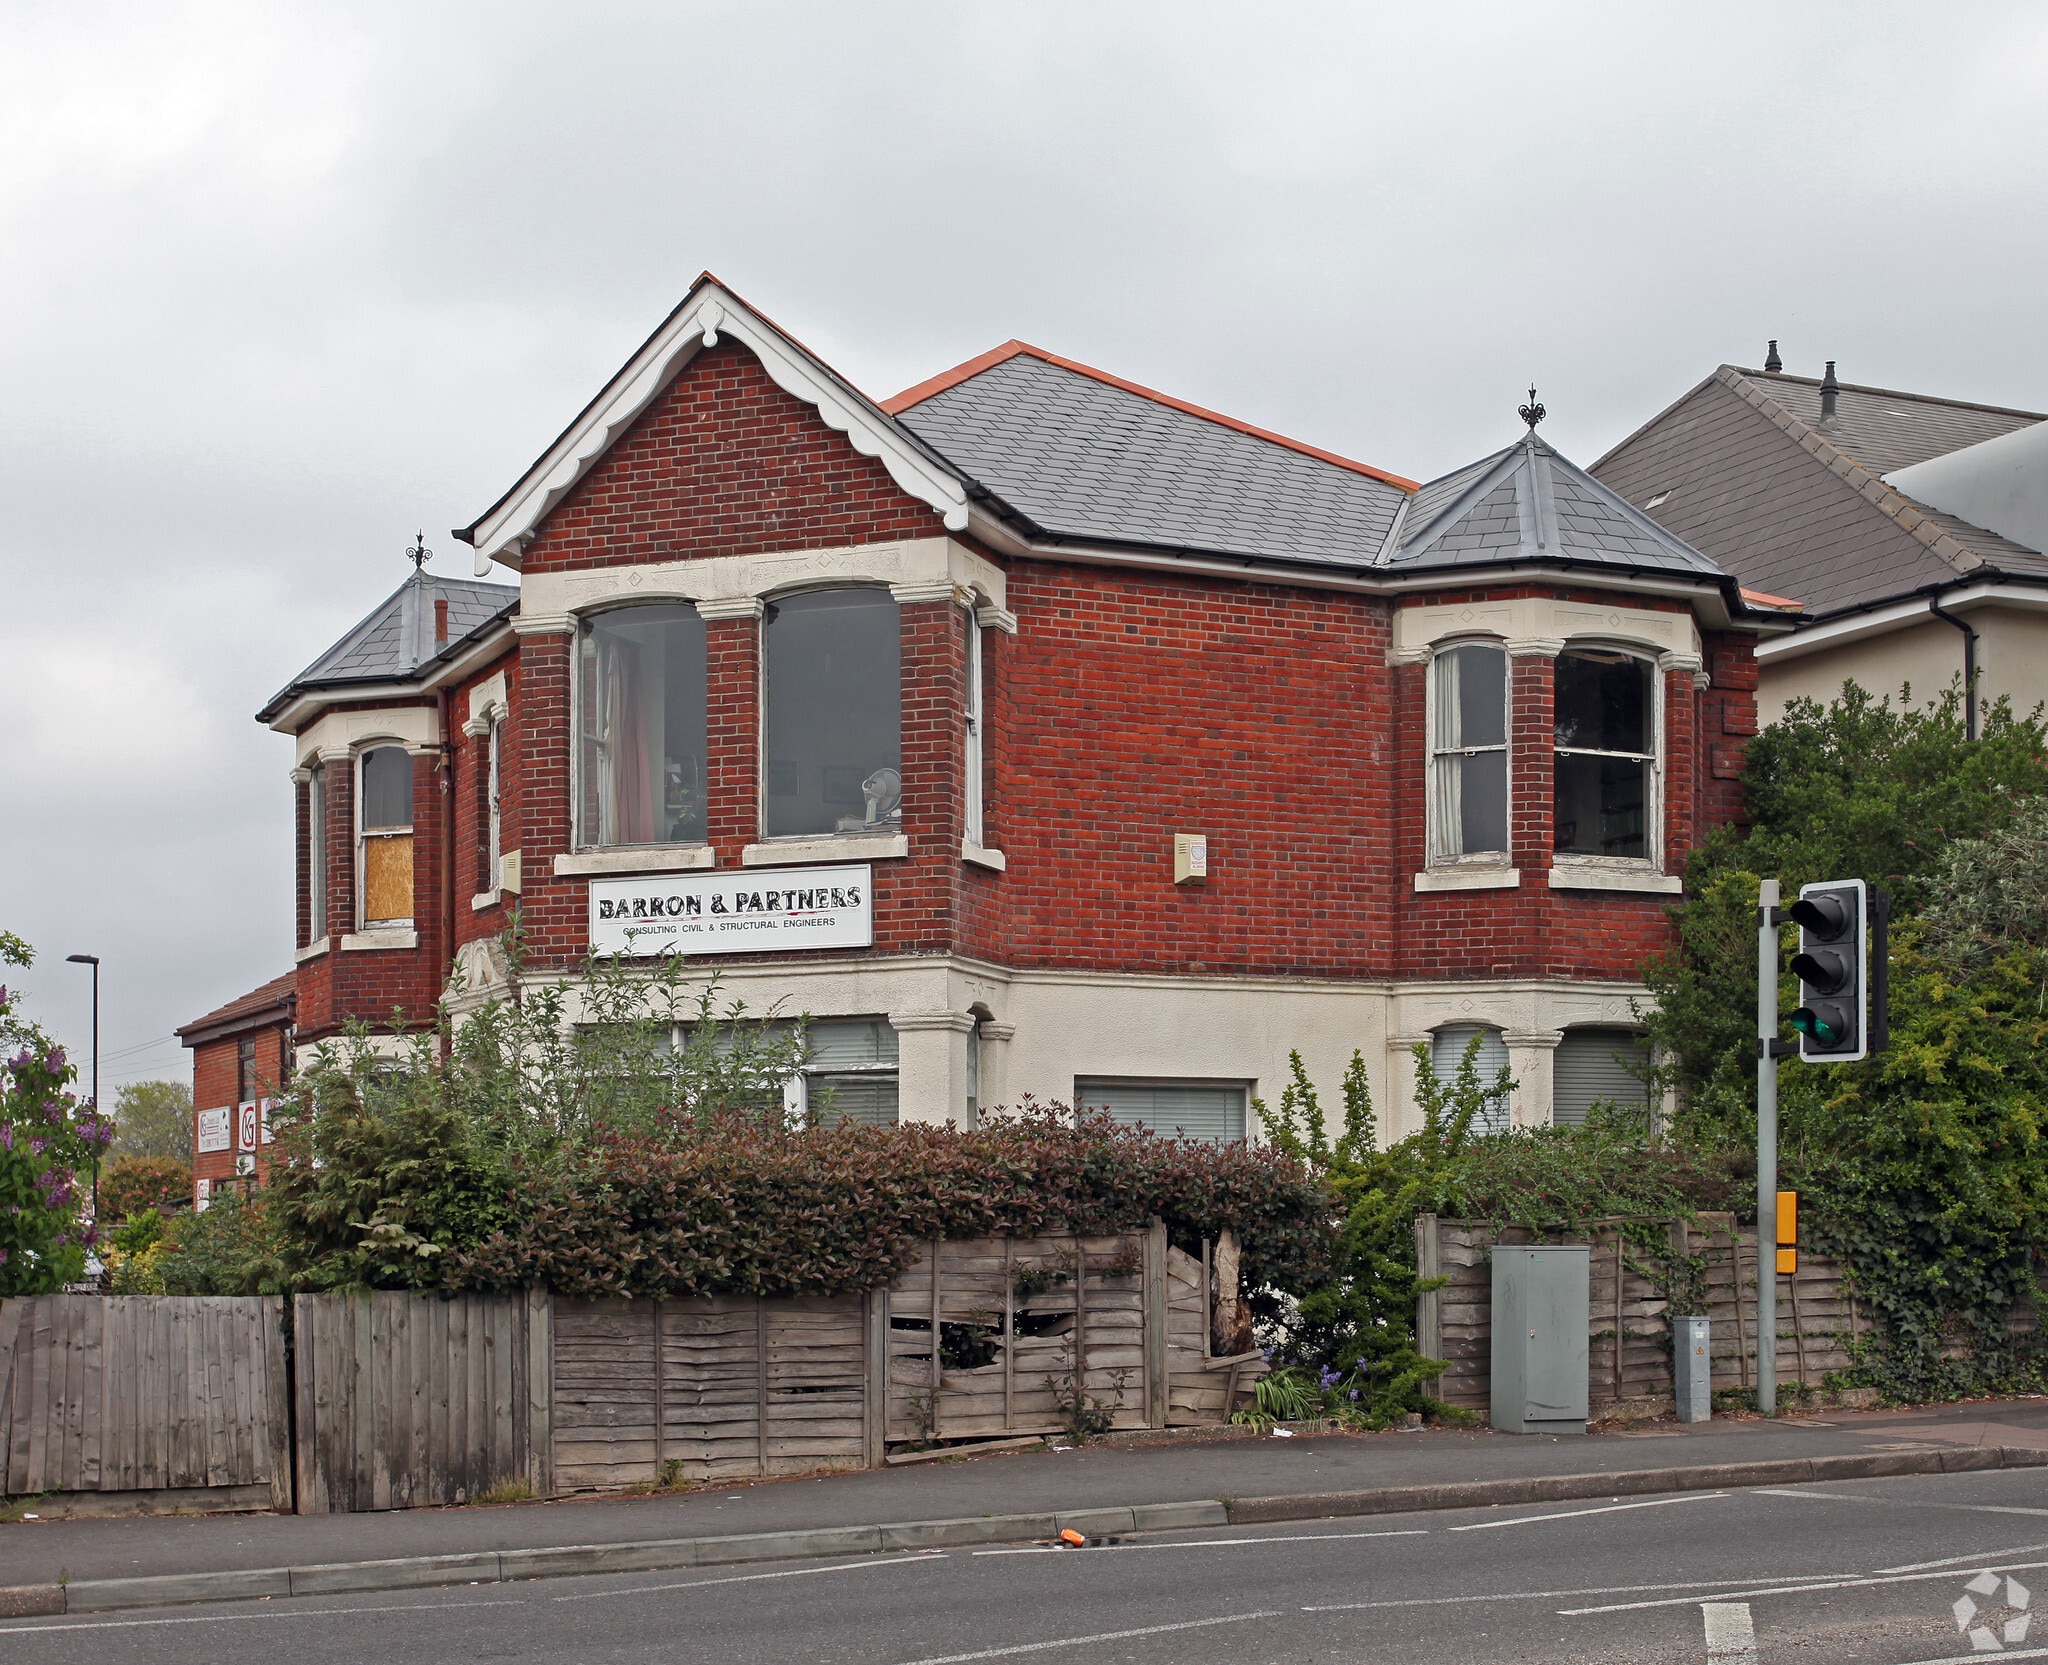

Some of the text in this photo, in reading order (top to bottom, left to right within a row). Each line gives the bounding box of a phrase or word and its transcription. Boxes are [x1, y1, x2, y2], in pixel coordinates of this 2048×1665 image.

[599, 886, 861, 919] BARRON & PARTNERS
[623, 918, 836, 935] CONSULTING CIVIL & STRUCTURAL ENGINEERS
